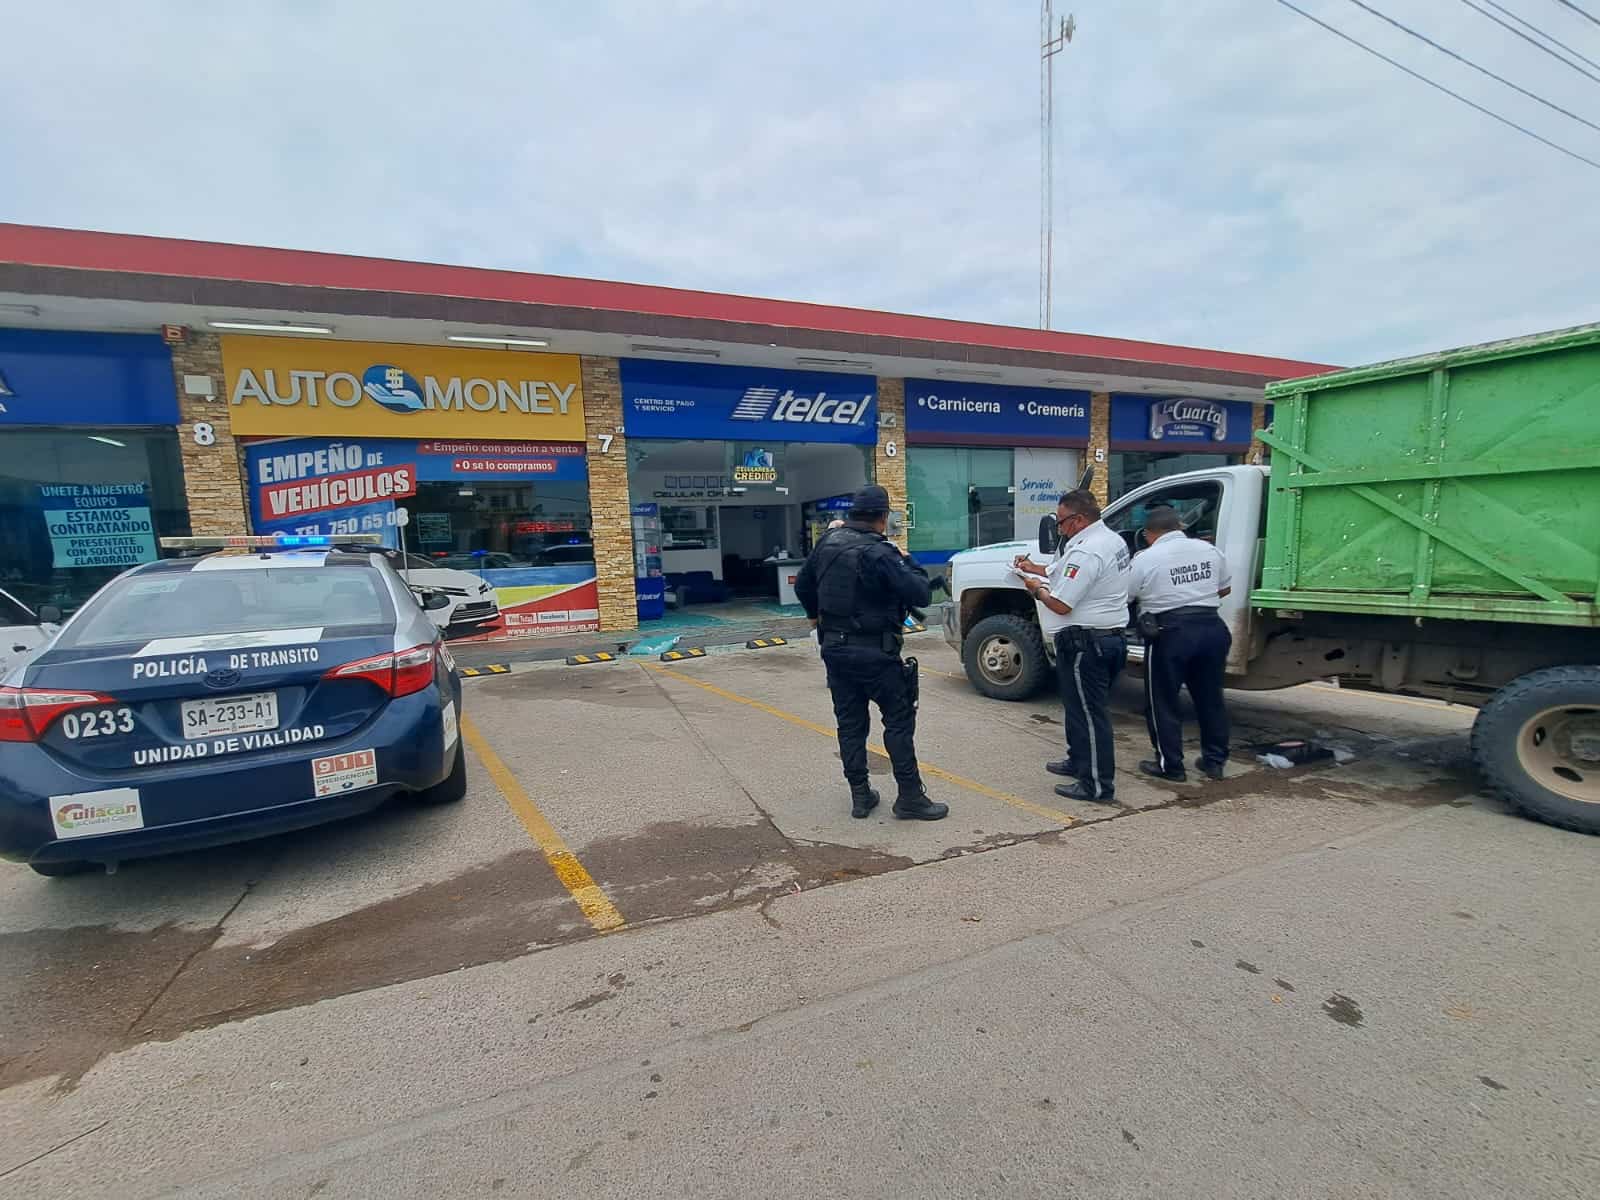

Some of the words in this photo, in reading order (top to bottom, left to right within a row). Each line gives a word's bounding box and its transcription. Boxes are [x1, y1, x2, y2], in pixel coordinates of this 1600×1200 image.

[231, 368, 363, 407] AUTO
[423, 376, 576, 415] MONEY
[772, 390, 872, 425] telcel
[1173, 400, 1222, 425] Cuarta
[193, 422, 216, 446] 8
[433, 442, 479, 453] Empeño
[481, 444, 501, 453] con
[598, 434, 614, 453] 7
[885, 441, 897, 457] 6
[1095, 448, 1105, 462] 5
[258, 443, 363, 484] EMPEÑO
[366, 452, 383, 466] DE
[472, 462, 484, 470] se
[486, 460, 495, 470] lo
[496, 462, 553, 472] compramos
[93, 484, 144, 496] NUESTRO
[268, 469, 410, 515] VEHÍCULOS
[1022, 477, 1056, 491] Servicio
[74, 496, 118, 508] EQUIPO
[66, 509, 130, 523] ESTAMOS
[50, 520, 150, 536] CONTRATANDO
[329, 517, 358, 536] 750
[361, 513, 384, 531] 65
[66, 548, 88, 558] CON
[89, 545, 144, 555] SOLICITUD
[74, 554, 139, 566] ELABORADA
[1170, 564, 1198, 576] UNIDAD
[1200, 561, 1212, 571] DE
[1171, 570, 1212, 586] VIALIDAD
[133, 656, 208, 680] POLICÍA
[230, 654, 249, 669] DE
[251, 647, 319, 668] TRANSITO
[187, 701, 273, 727] SA-233-A1
[63, 708, 135, 739] 0233
[134, 744, 207, 765] UNIDAD
[214, 739, 240, 754] DE
[242, 725, 325, 750] VIALIDAD
